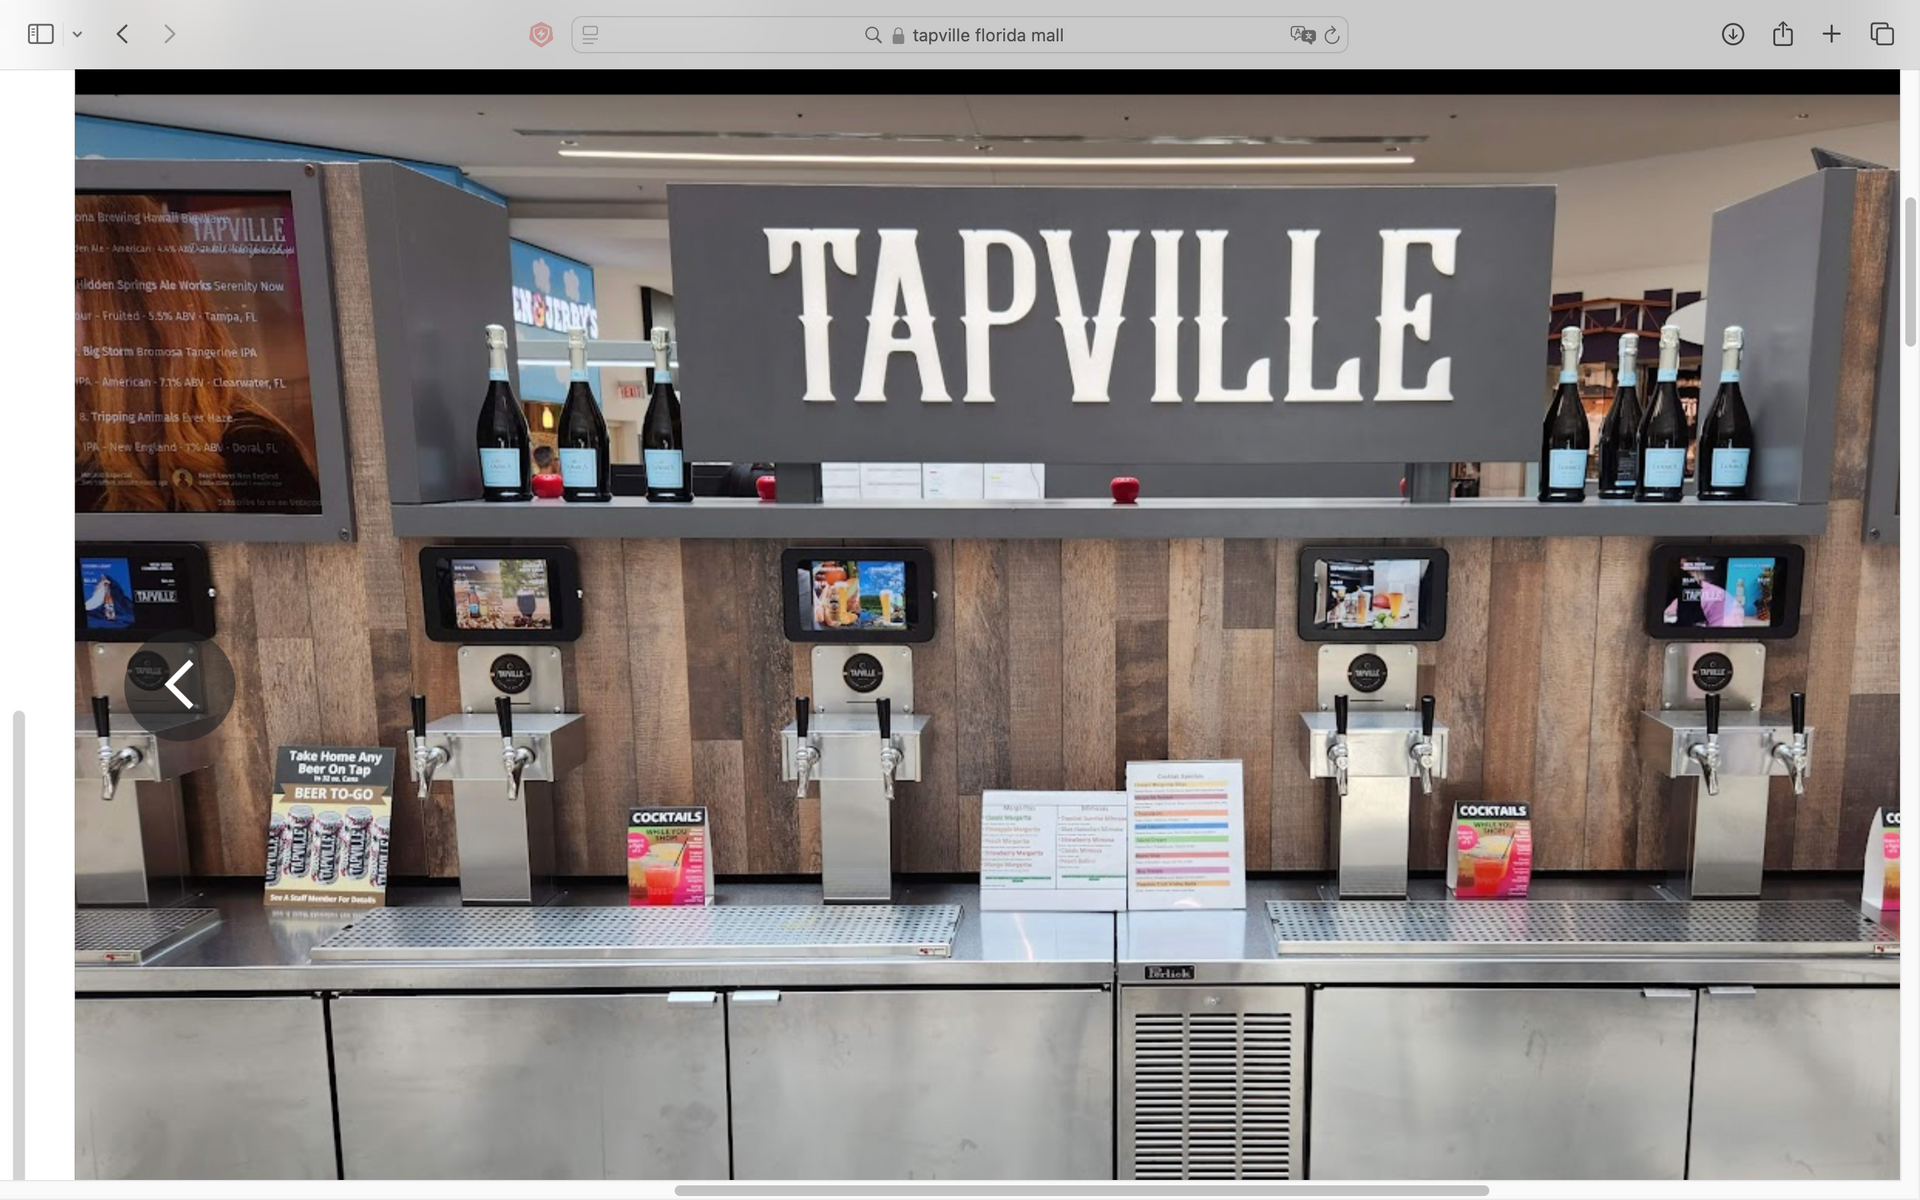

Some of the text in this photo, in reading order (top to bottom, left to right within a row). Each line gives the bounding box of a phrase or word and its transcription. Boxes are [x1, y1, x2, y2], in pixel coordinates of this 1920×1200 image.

[97, 212, 141, 225] Brewing
[143, 212, 179, 223] Hawaii
[192, 217, 287, 242] TAPVILLE
[112, 244, 151, 252] American
[76, 279, 284, 294] Hidden Springs Ale Works Serenity Now
[102, 310, 140, 321] Fruited
[148, 311, 173, 322] 5.5%
[176, 312, 196, 322] ABV
[204, 312, 243, 324] Tampa,
[245, 312, 258, 323] FL
[545, 294, 599, 339] JERRY'S
[763, 227, 1462, 403] TAPVILLE
[82, 345, 258, 361] Big Storm Bromosa Tangerine IPA
[102, 376, 151, 388] American
[160, 377, 182, 388] 7.1%
[183, 378, 204, 388] ABV
[213, 378, 272, 390] Clearwater,
[274, 379, 287, 389] FL
[91, 411, 136, 424] Tripping
[137, 411, 180, 423] Animals
[182, 413, 204, 423] Ever
[206, 413, 234, 423] Haze
[82, 442, 100, 452] IPA
[109, 442, 132, 452] New
[134, 441, 177, 455] England
[233, 443, 263, 454] Doral,
[265, 443, 278, 454] FL
[136, 591, 176, 602] TAPVILLE
[498, 670, 524, 678] TAPVILLE
[850, 669, 876, 677] TAPVILLE
[1355, 669, 1380, 677] TAPVILLE
[1700, 668, 1726, 676] TAPVILLE
[289, 750, 382, 766] Take Home Any
[298, 763, 372, 778] Beer On Tap
[294, 787, 374, 800] BEER TO-GO
[632, 811, 702, 823] COCKTAILS
[1460, 806, 1527, 816] COCKTAILS
[270, 894, 282, 902] See
[290, 894, 308, 902] Staff
[308, 894, 338, 903] Member
[351, 896, 377, 904] Details
[1147, 966, 1192, 978] Perlick
